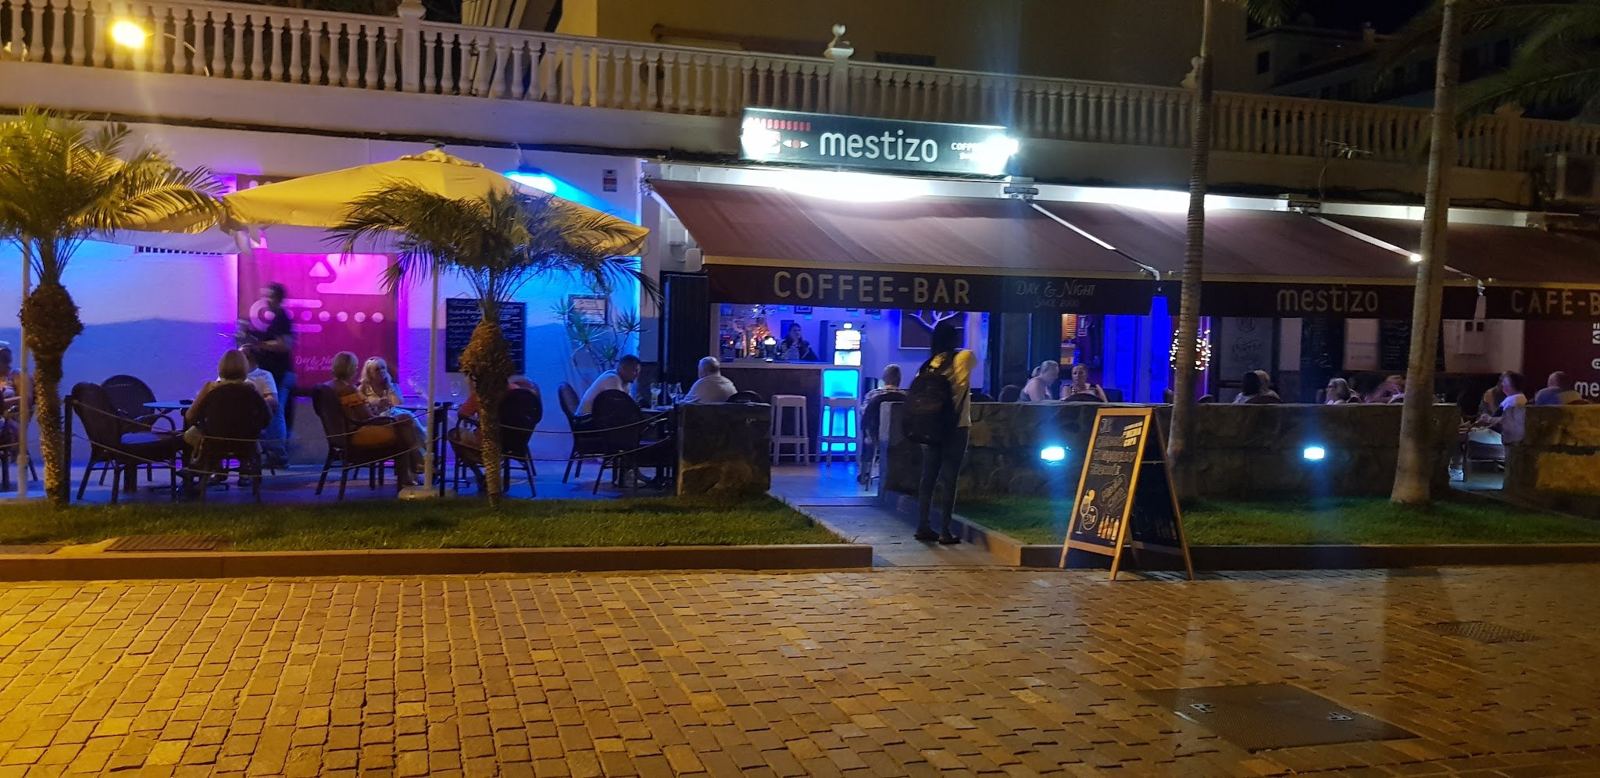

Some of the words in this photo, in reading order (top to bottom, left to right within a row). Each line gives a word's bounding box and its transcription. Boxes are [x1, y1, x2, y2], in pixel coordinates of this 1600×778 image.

[819, 130, 938, 163] mestizo
[773, 271, 970, 305] COFFEE-BAR
[1277, 285, 1378, 312] mestizo
